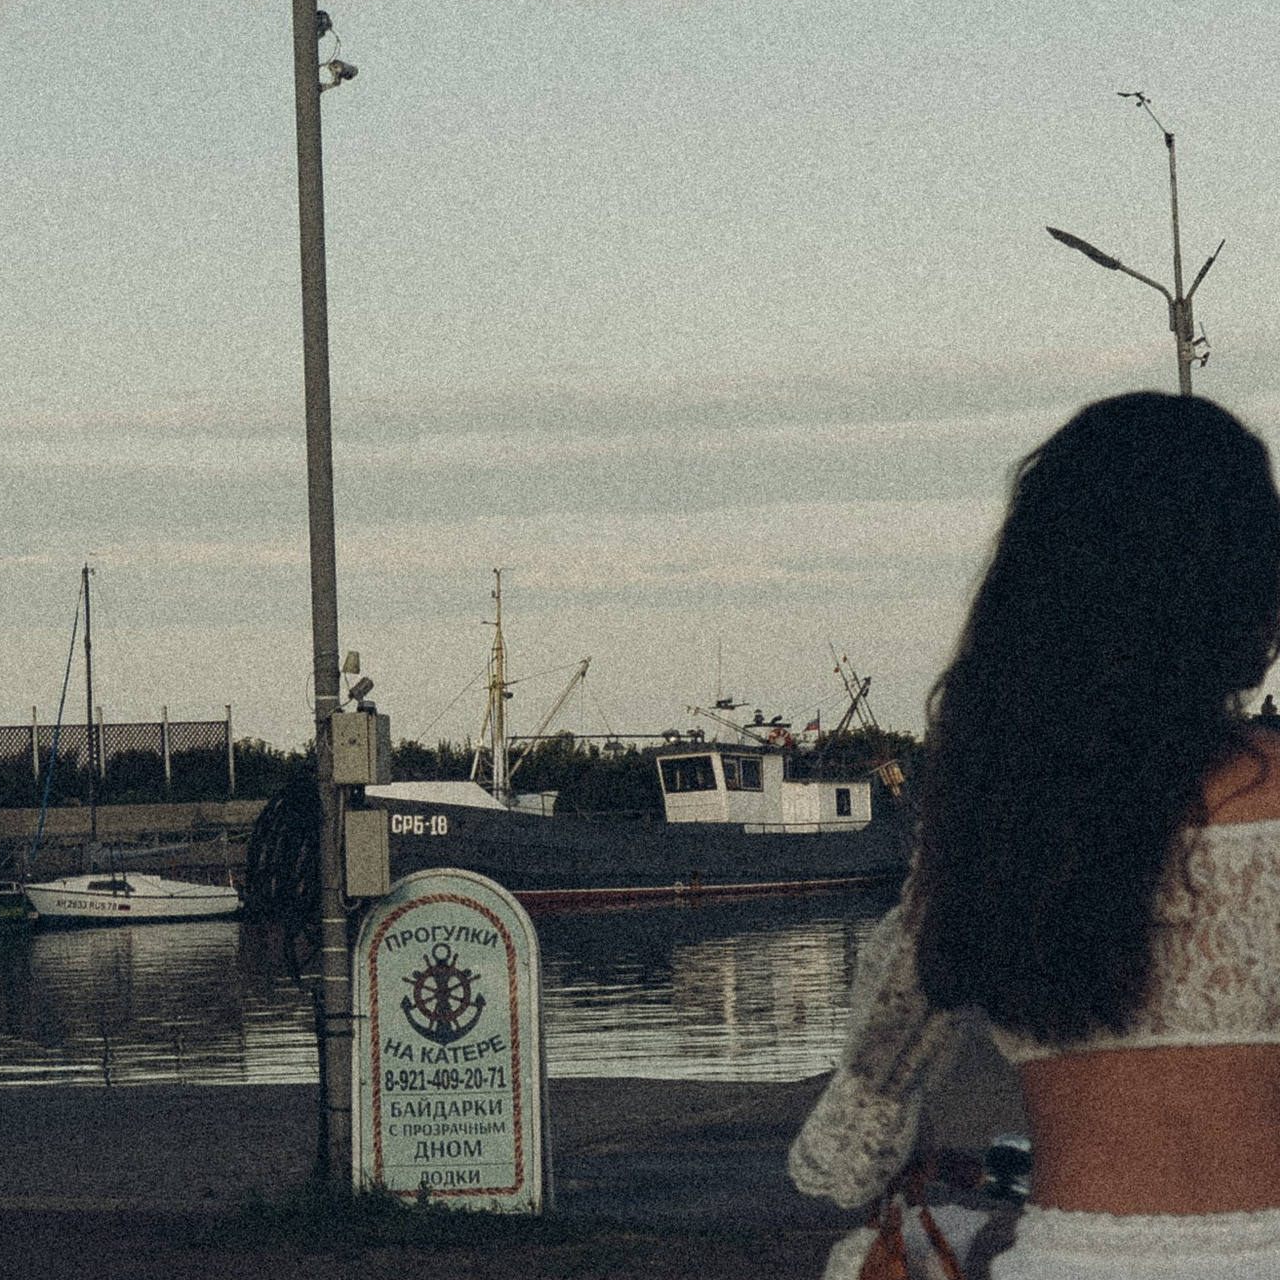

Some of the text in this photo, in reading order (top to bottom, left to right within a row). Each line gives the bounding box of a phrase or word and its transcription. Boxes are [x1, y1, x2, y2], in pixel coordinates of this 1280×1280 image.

[391, 814, 448, 835] СРБ-18
[384, 925, 499, 952] ПРОГУЛКИ
[383, 1034, 507, 1065] НА КАТЕРЕ
[385, 1066, 507, 1091] 8-921-409-20-71
[390, 1097, 503, 1120] БАЙДАРКИ
[389, 1122, 506, 1137] С ПРОЗРАЧНЫМ
[414, 1140, 483, 1162] ДНОМ
[421, 1170, 481, 1187] ЛОДКИ
